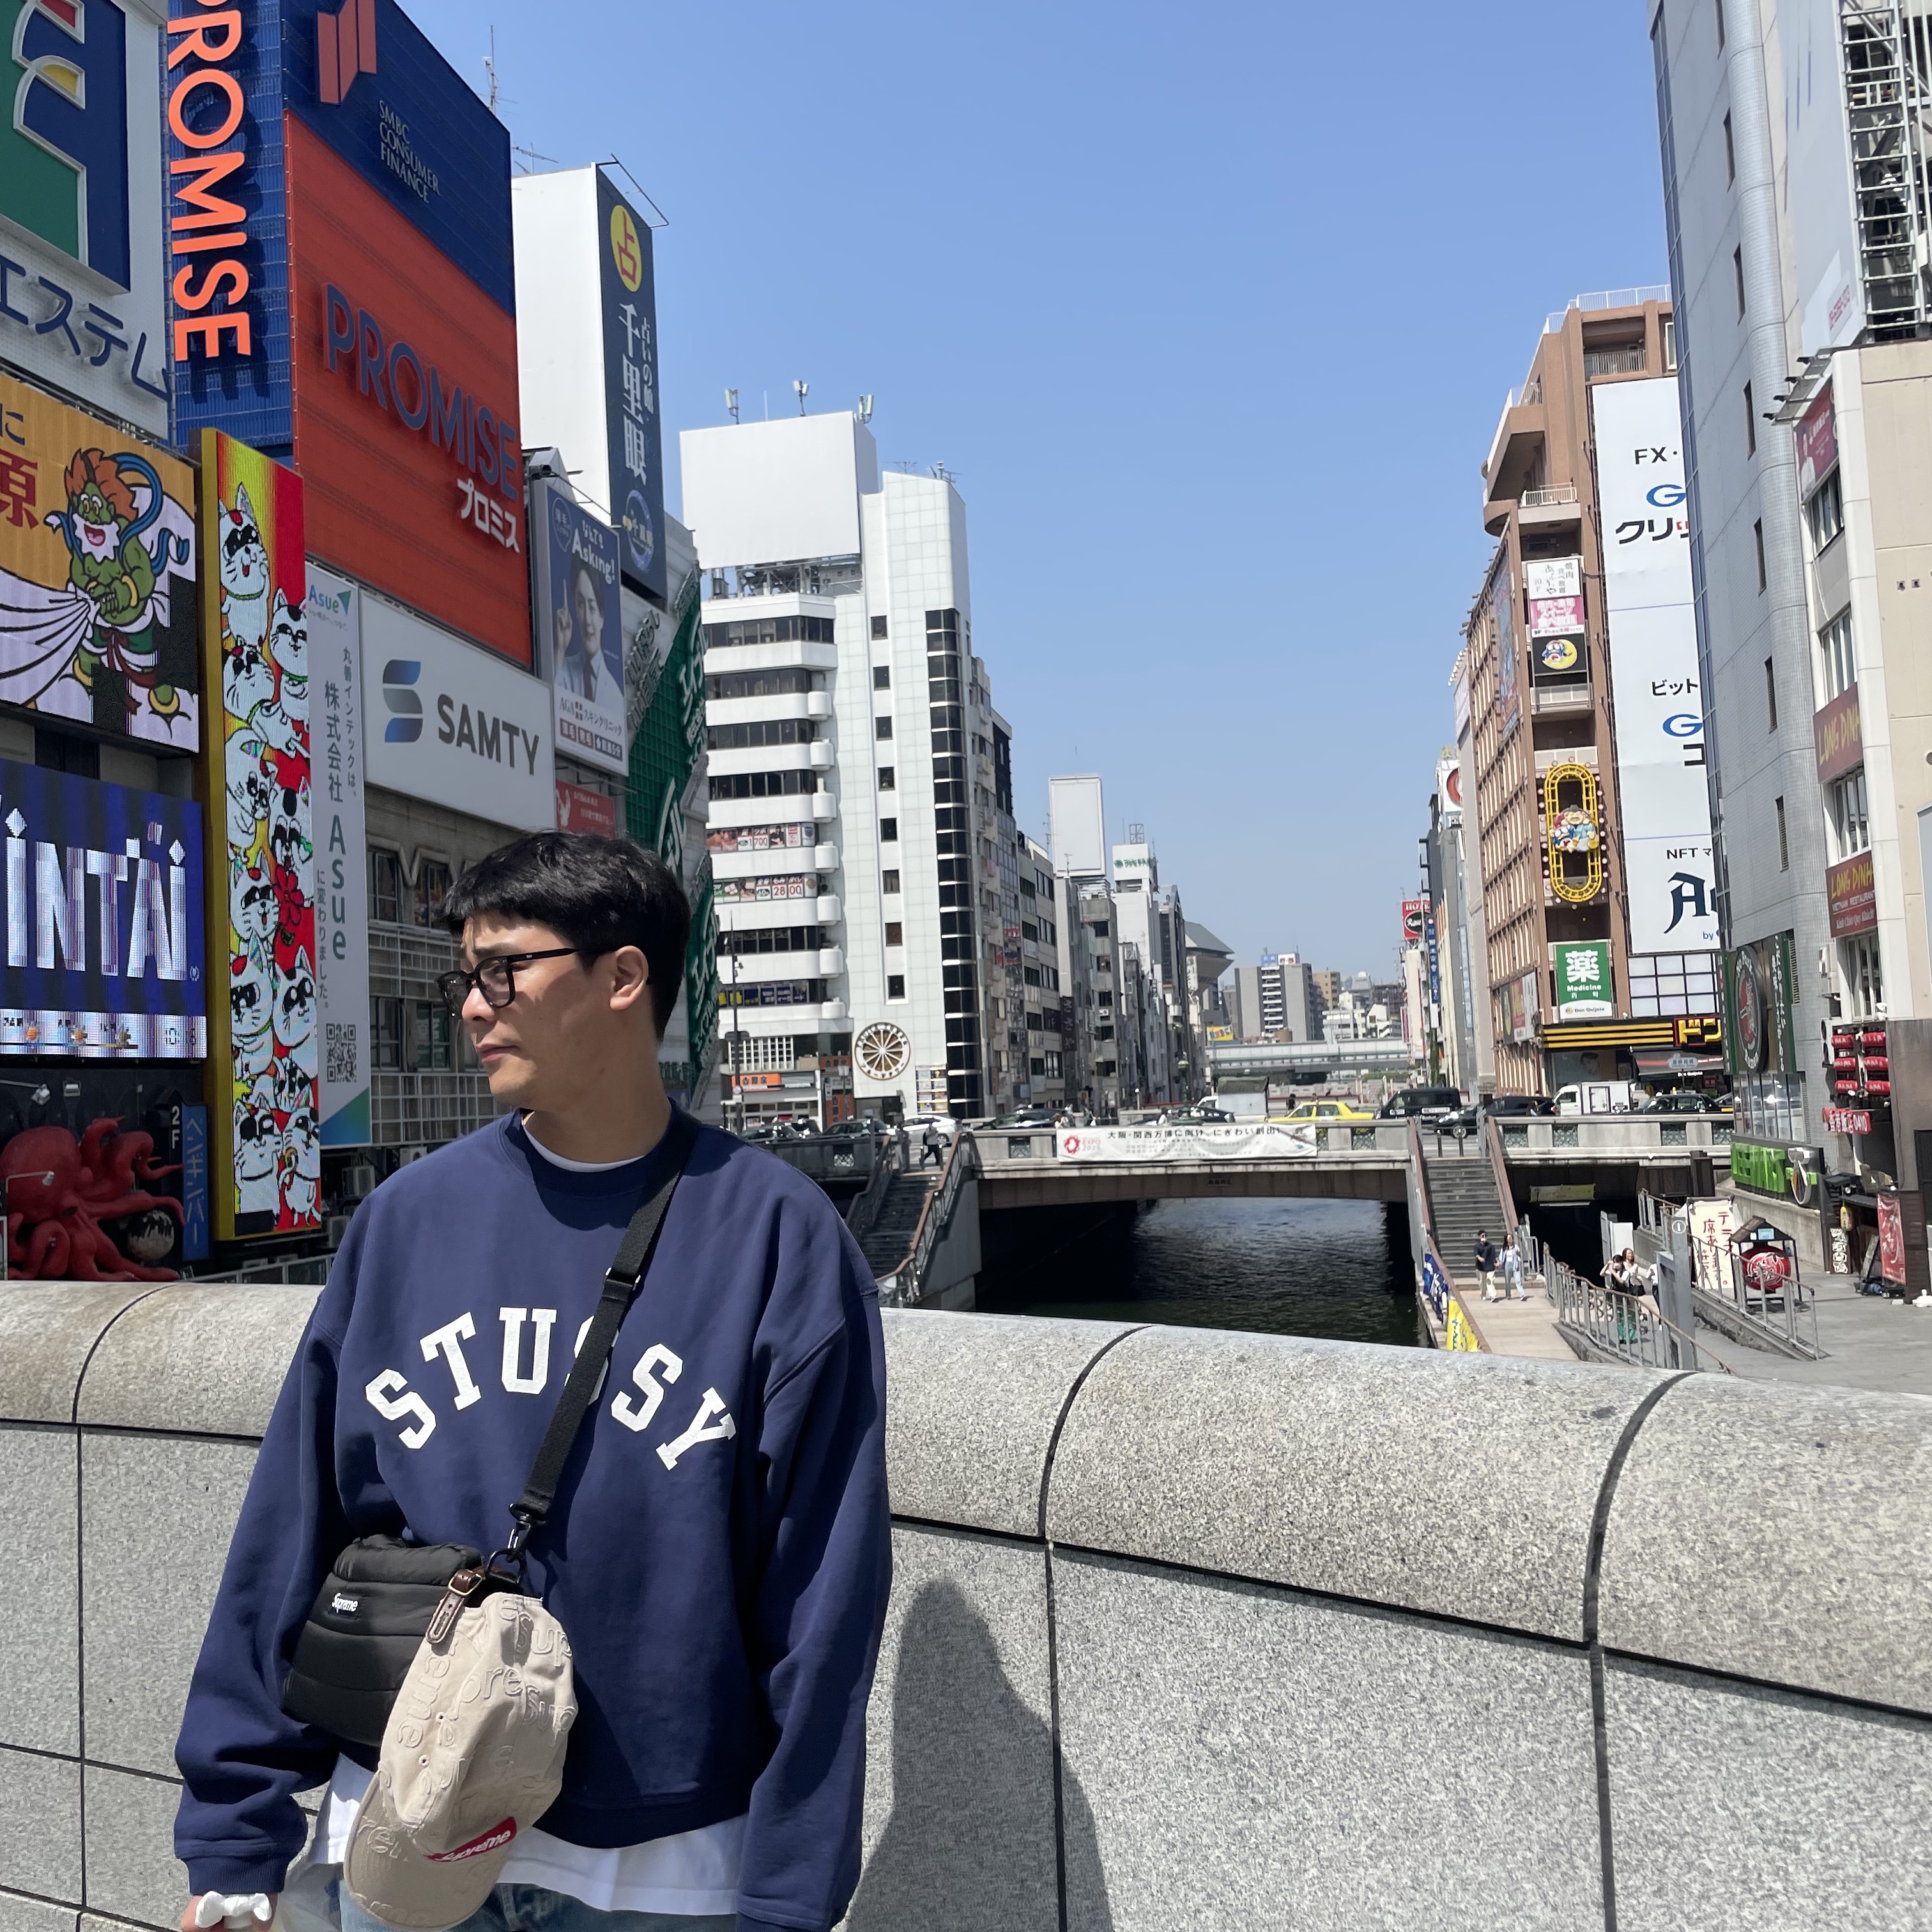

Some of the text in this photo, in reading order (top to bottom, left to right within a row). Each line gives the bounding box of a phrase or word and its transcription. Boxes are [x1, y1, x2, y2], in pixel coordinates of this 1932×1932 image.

[379, 100, 410, 144] SMBC
[167, 0, 252, 363] ROMISE
[379, 122, 441, 196] CONSUMER
[381, 141, 429, 203] FINANCE
[617, 211, 637, 285] 占
[325, 283, 519, 501] PROMISE
[457, 478, 520, 554] プロミス
[572, 527, 616, 585] Asking!
[309, 583, 339, 614] Asue
[437, 693, 540, 776] SAMTY
[1818, 716, 1839, 767] LONG
[325, 680, 346, 961] 株式会社 Asue
[1666, 847, 1697, 860] NFT
[1831, 861, 1873, 900] LONG DINH
[1664, 871, 1718, 934] A
[1703, 931, 1714, 941] by
[1565, 949, 1600, 983] 薬
[1567, 984, 1602, 992] Medicine
[171, 1105, 181, 1149] 2F
